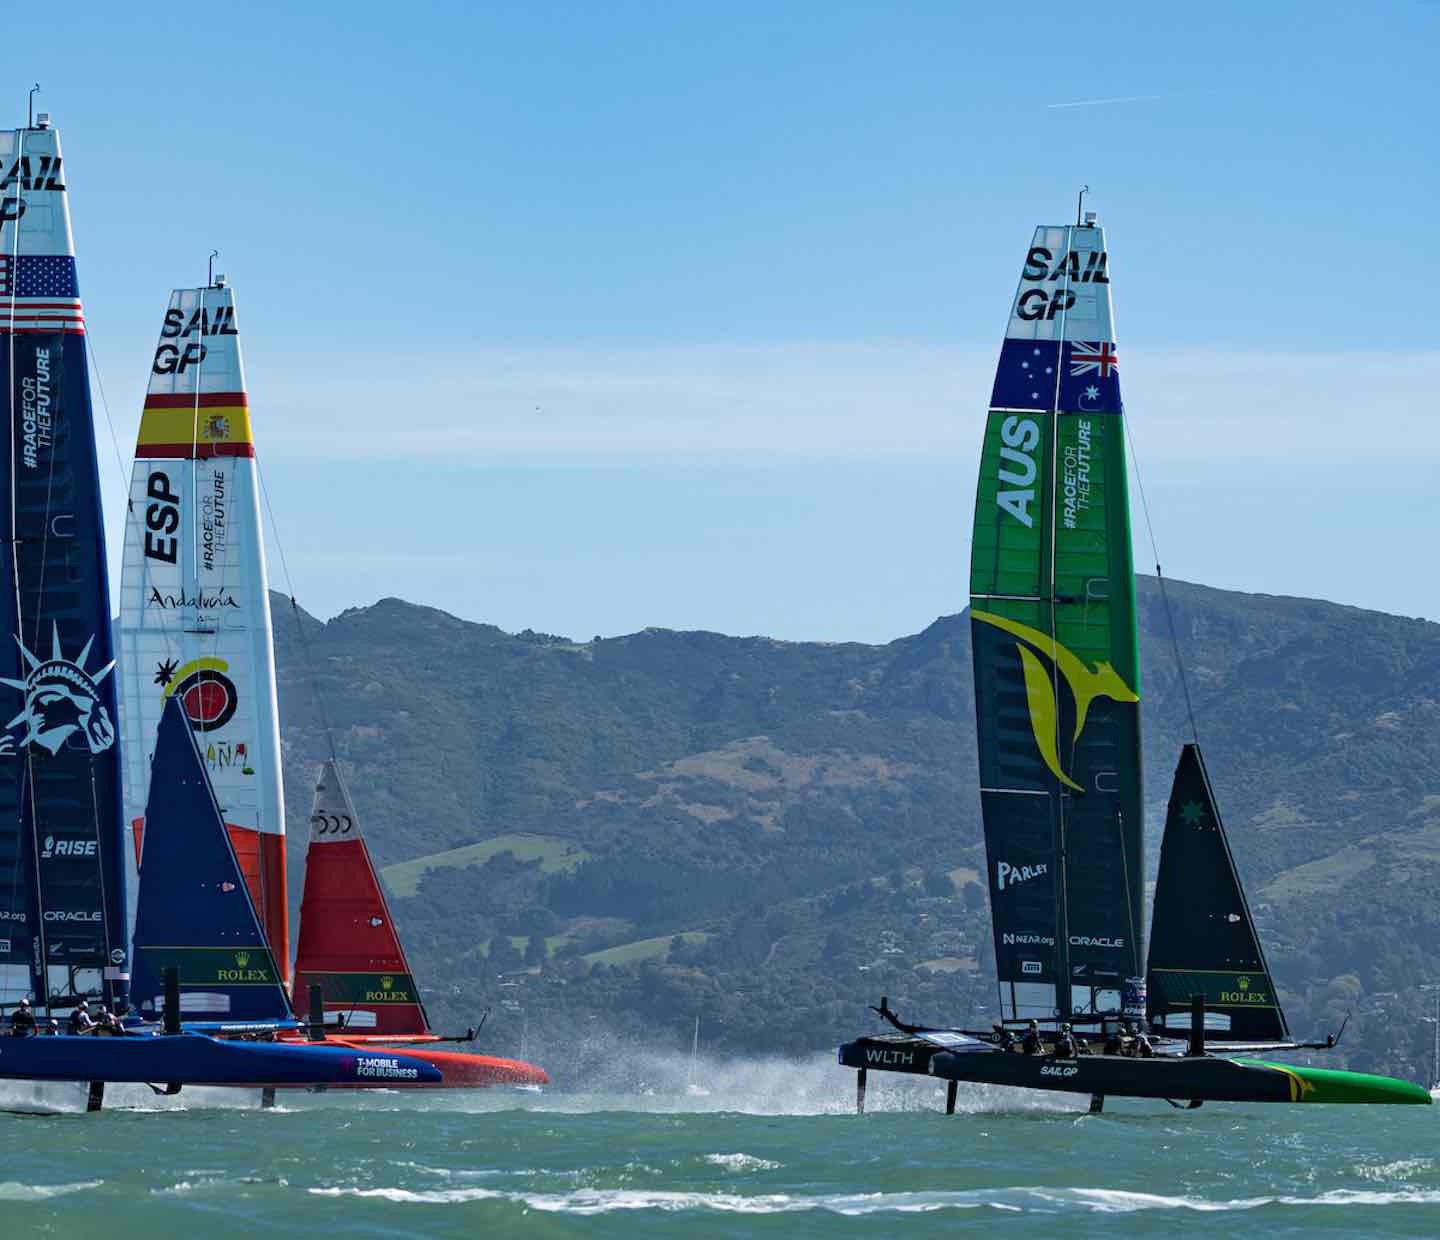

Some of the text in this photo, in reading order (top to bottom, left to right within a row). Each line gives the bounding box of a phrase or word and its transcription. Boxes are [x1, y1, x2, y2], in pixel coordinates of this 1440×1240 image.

[1022, 247, 1110, 284] SAIL
[1016, 289, 1076, 320] GP
[161, 306, 238, 337] SAIL
[152, 344, 207, 375] GP
[36, 347, 50, 447] THEFUTURE
[24, 377, 38, 471] #RACEFOR
[996, 416, 1040, 528] AUS
[1077, 419, 1091, 511] THEFUTURE
[1064, 446, 1078, 528] #RACEFOR
[144, 472, 180, 564] ESP
[214, 471, 225, 555] THEFUTURE
[203, 495, 214, 571] #RACEFOR
[207, 741, 248, 770] AÑA
[55, 840, 97, 855] RISE
[44, 911, 102, 920] ORACLE
[1016, 936, 1054, 946] NEAR.org
[1069, 936, 1125, 947] ORACLE
[218, 970, 268, 981] ROLEX
[366, 992, 408, 1001] ROLEX
[1221, 992, 1265, 1002] ROLEX
[357, 1058, 398, 1068] T-MOBILE
[357, 1066, 417, 1078] FOR BUSINESS
[866, 1049, 913, 1065] WLTH
